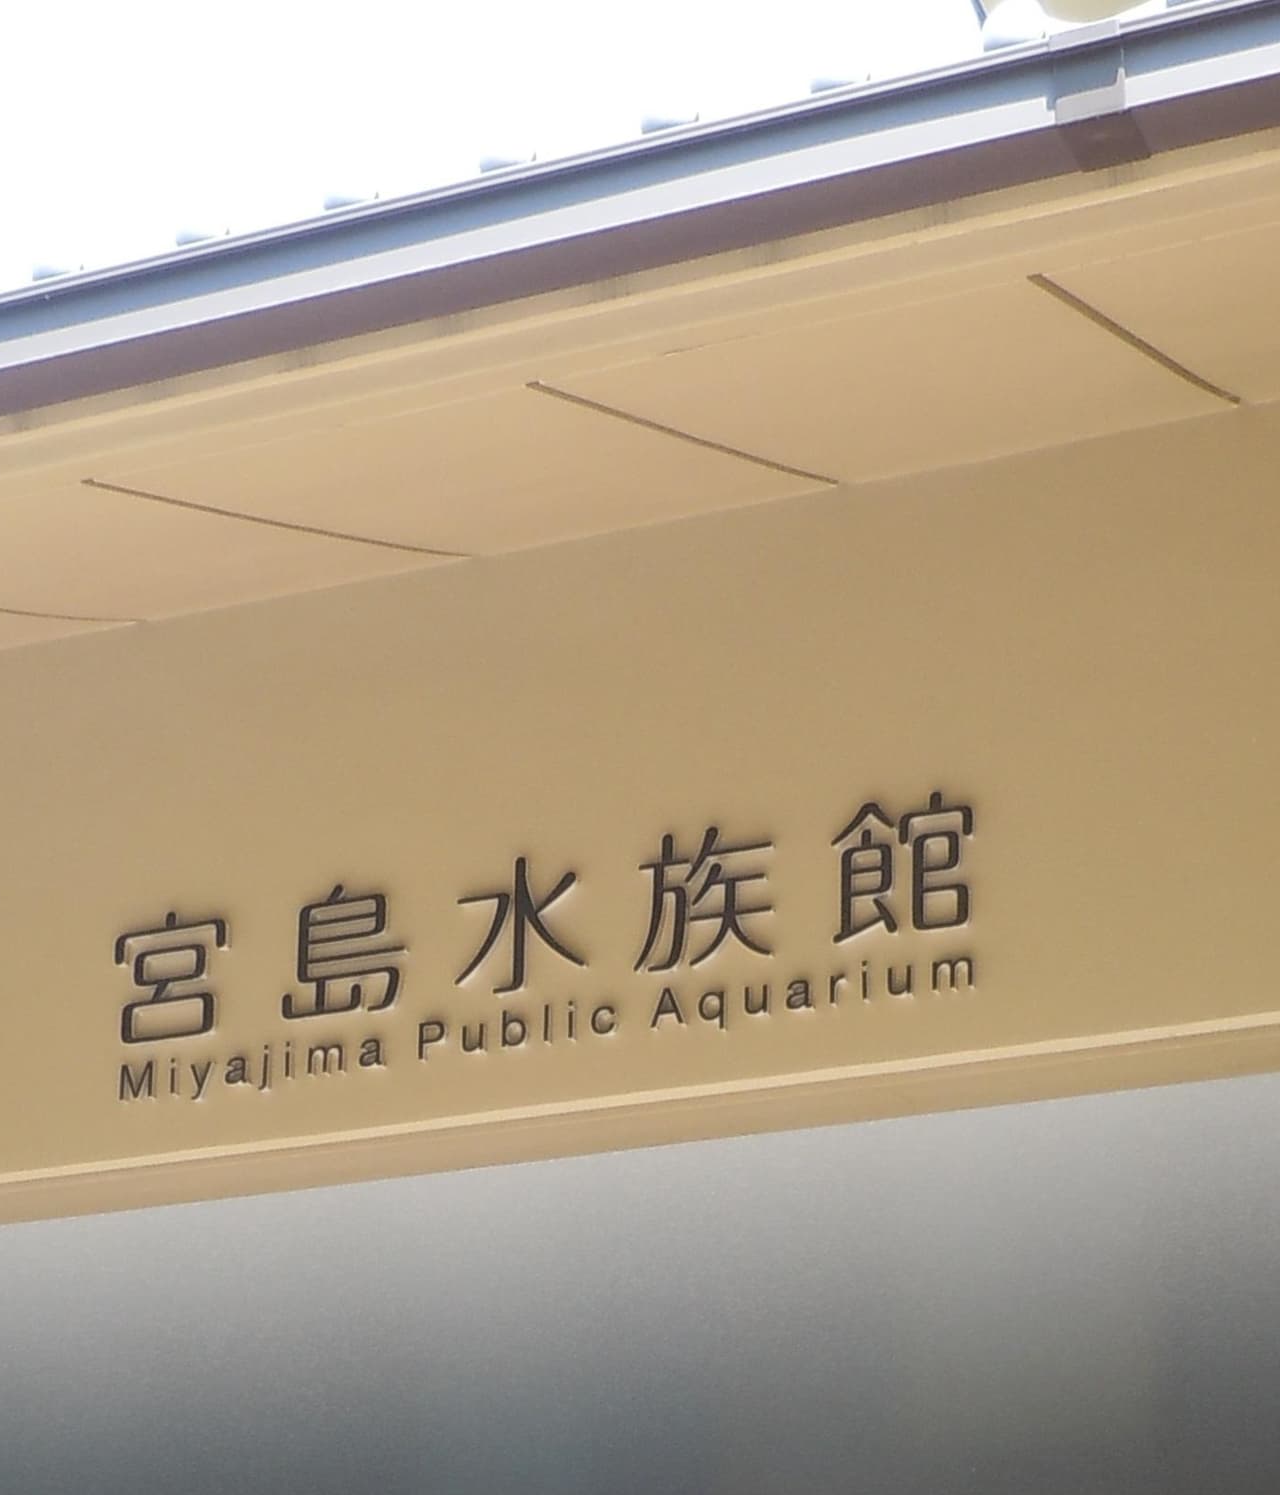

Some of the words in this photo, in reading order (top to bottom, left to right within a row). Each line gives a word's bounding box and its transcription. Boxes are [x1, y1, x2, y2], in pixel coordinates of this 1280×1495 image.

[114, 791, 976, 1045] 宮島水族館
[119, 1033, 387, 1100] Miyajima
[417, 999, 618, 1060] Public
[651, 951, 976, 1030] Aquarium
